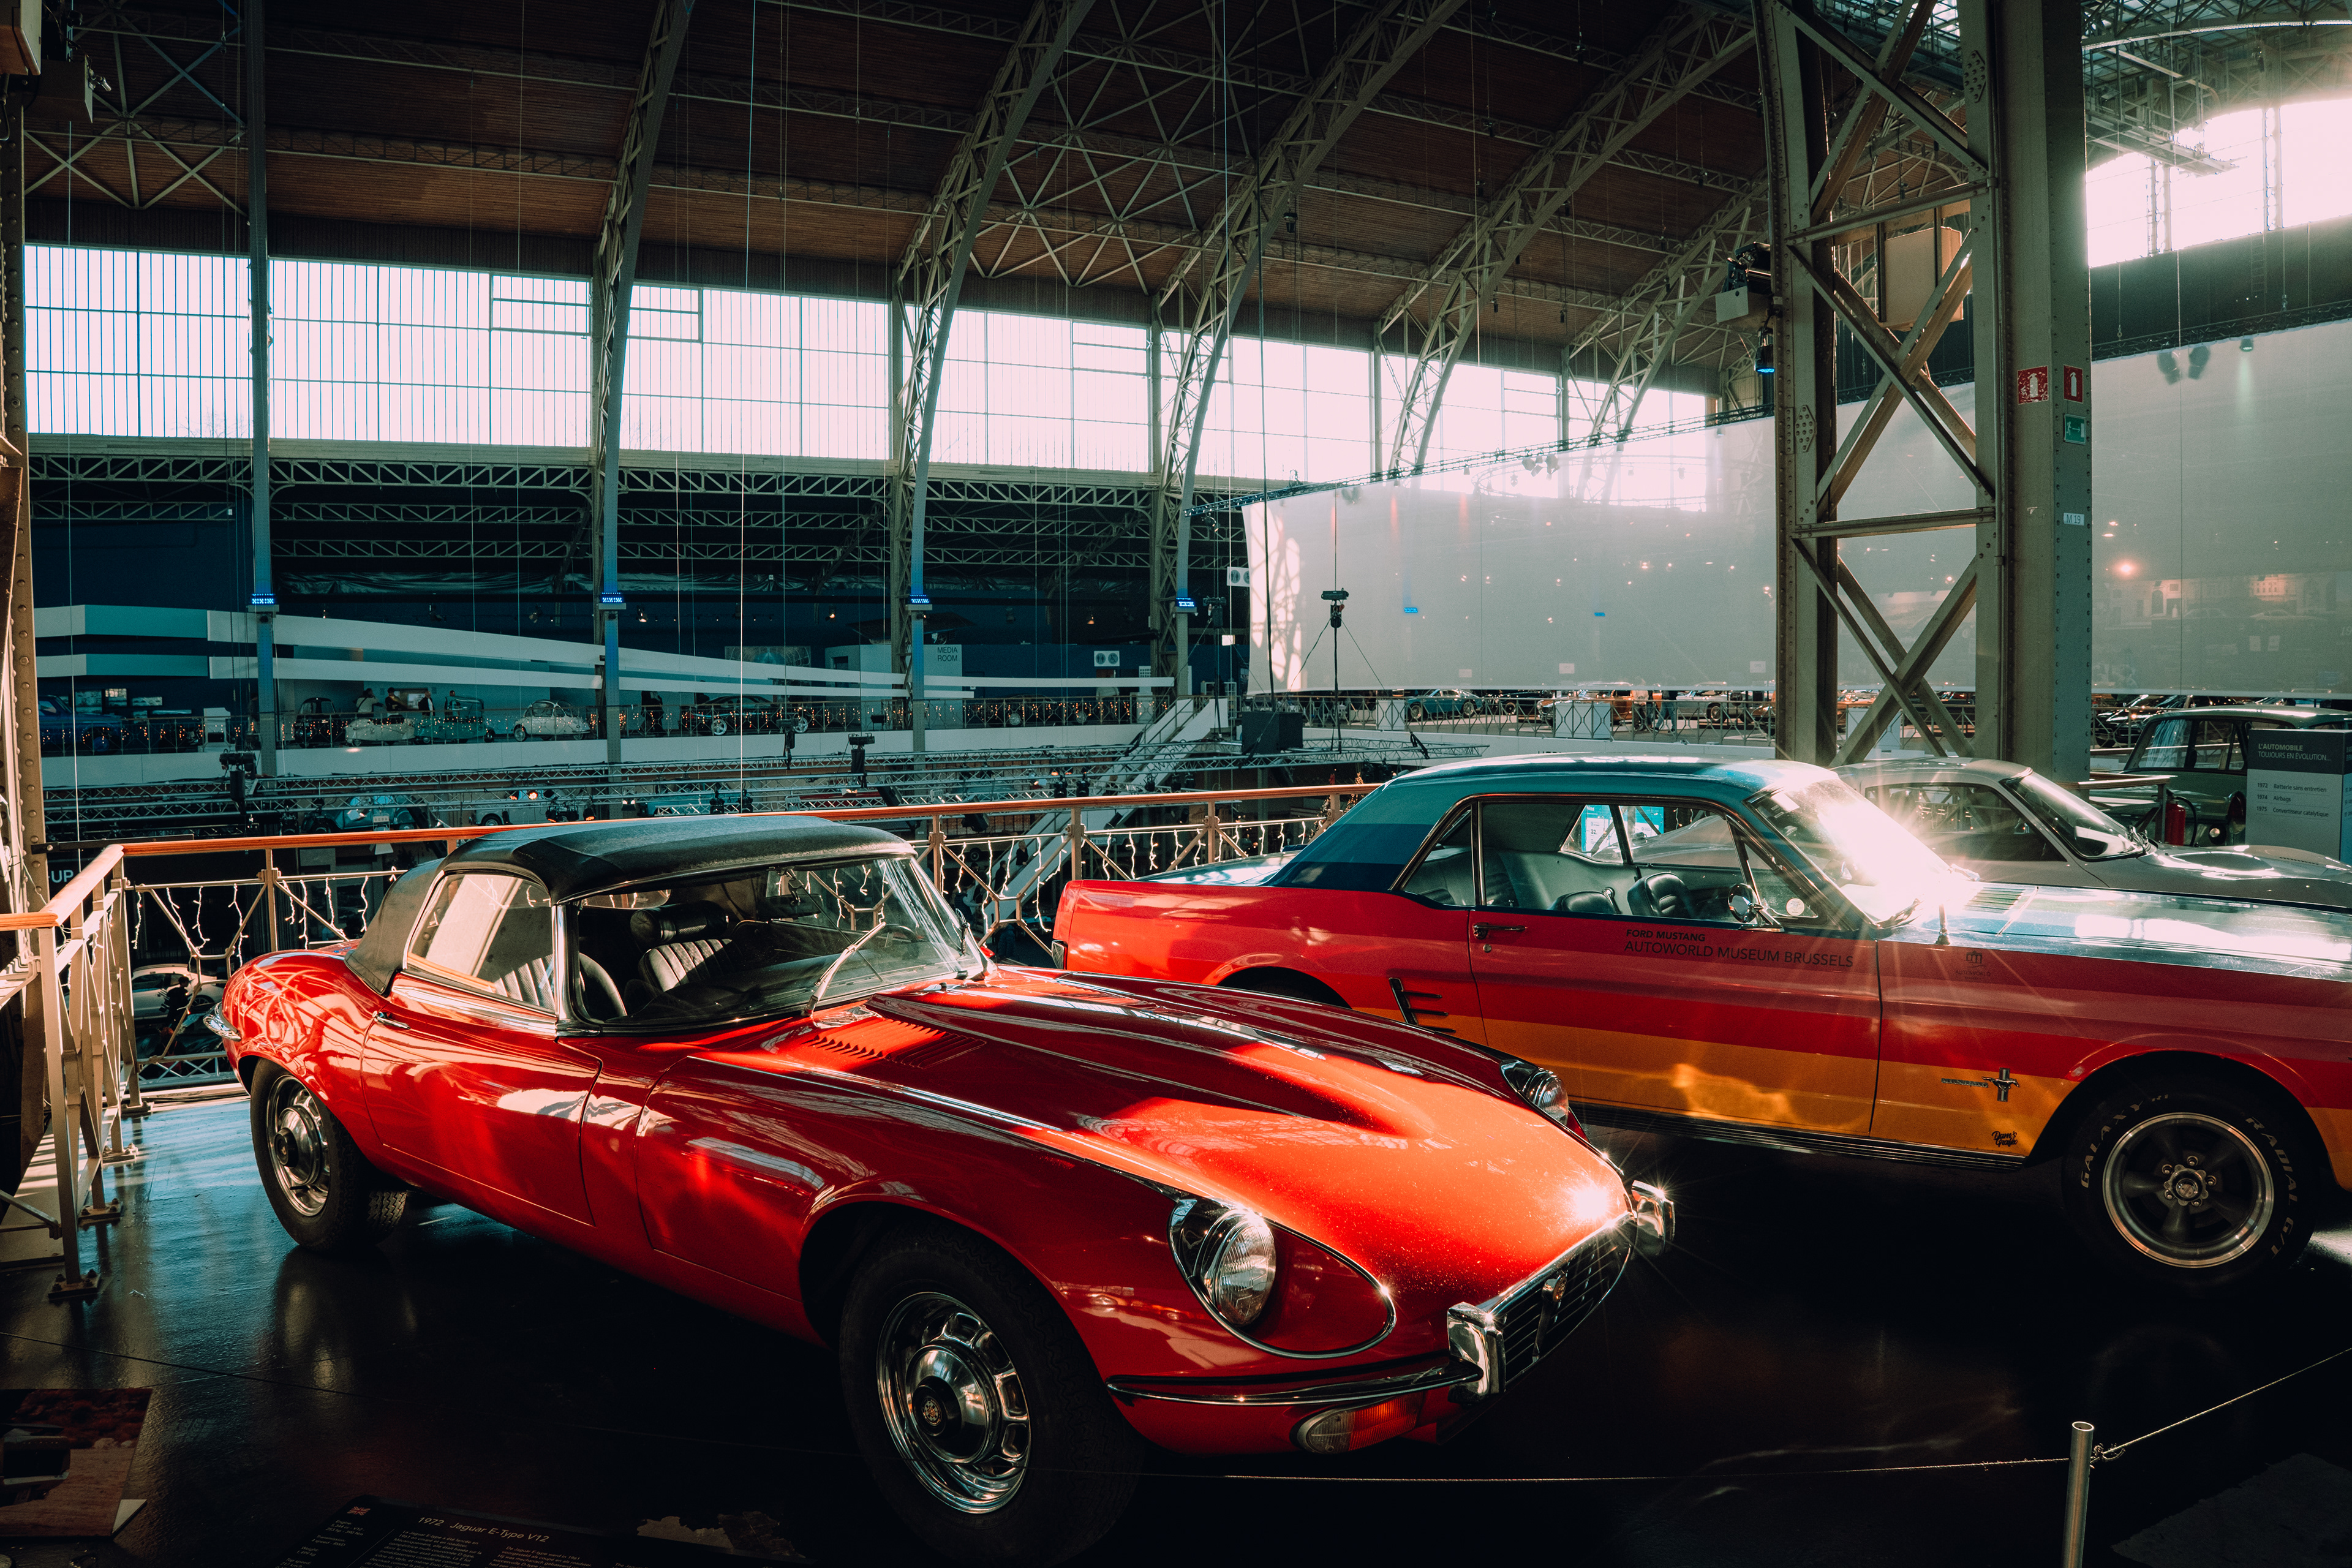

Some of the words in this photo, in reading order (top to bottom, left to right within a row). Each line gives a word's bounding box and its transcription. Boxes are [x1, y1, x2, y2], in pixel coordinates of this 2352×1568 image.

[2067, 514, 2073, 523] M
[2074, 515, 2081, 524] 19
[2258, 743, 2303, 752] L'AUTOMOBILE
[1626, 929, 1653, 938] FORD
[1656, 930, 1706, 942] MUSTANG
[1624, 941, 1713, 958] AUTOWORLD
[1717, 946, 1780, 962] MUSEUM
[1784, 951, 1853, 968] BRUSSELS
[2081, 1100, 2144, 1188] GALAXY
[2245, 1116, 2299, 1206] RADIAL
[418, 1517, 445, 1526] 1972
[450, 1522, 488, 1533] Jaguar
[488, 1528, 524, 1539] E-Type
[527, 1533, 550, 1542] V12
